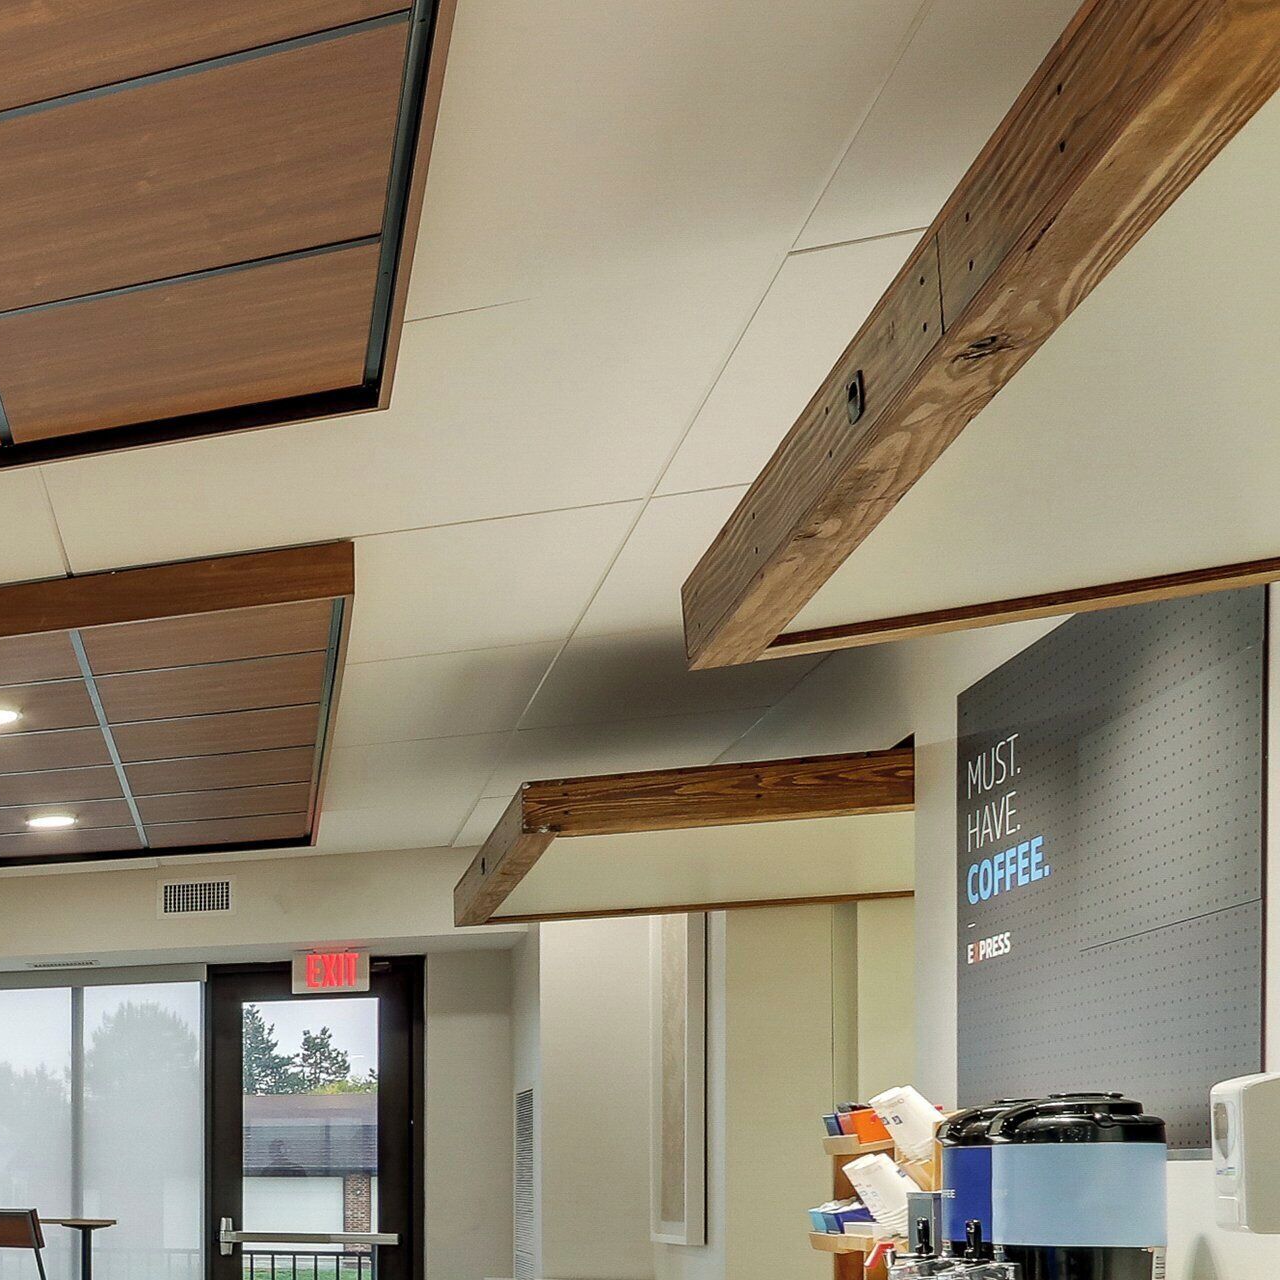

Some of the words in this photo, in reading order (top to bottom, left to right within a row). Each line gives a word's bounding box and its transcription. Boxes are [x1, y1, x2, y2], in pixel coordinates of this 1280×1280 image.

[967, 733, 1022, 800] MUST.
[967, 791, 1022, 853] HAVE.
[966, 835, 1051, 905] COFFEE.
[306, 952, 360, 988] EXIT
[967, 932, 1012, 965] EXPRESS
